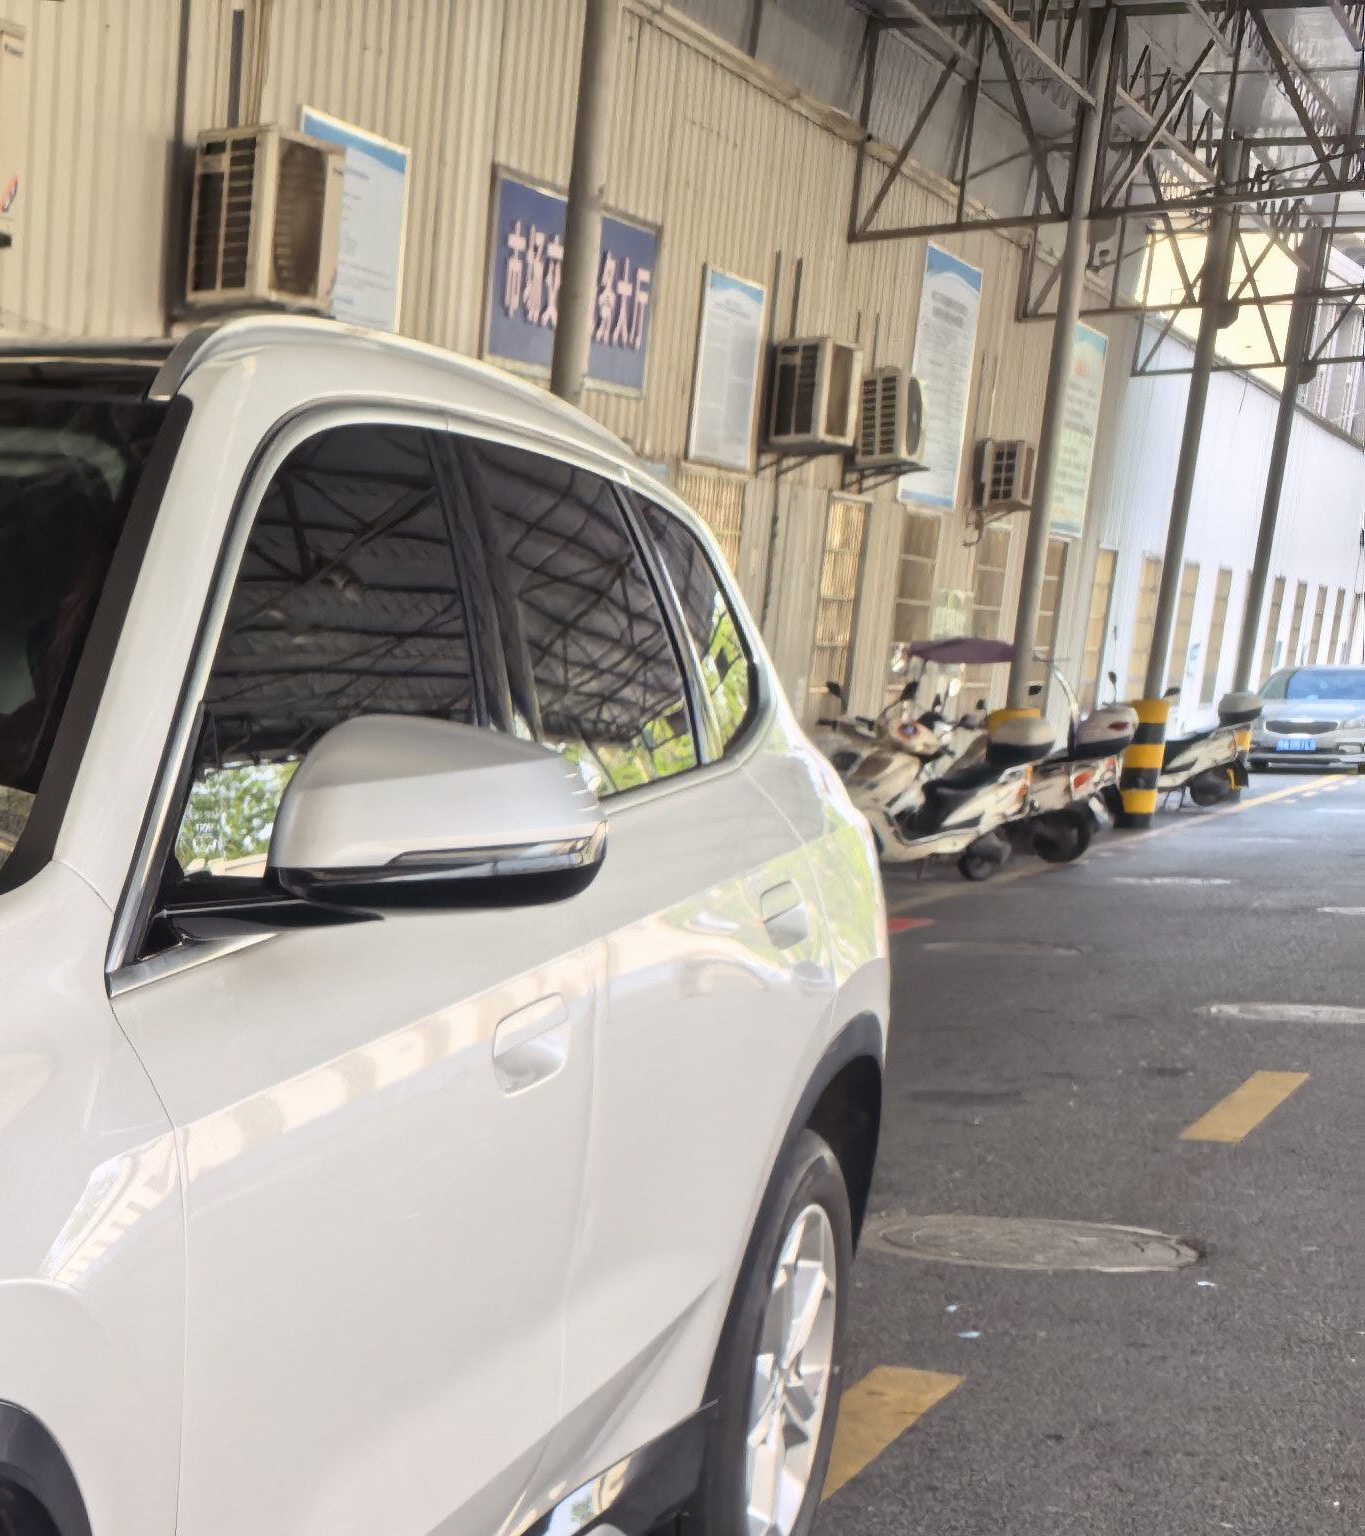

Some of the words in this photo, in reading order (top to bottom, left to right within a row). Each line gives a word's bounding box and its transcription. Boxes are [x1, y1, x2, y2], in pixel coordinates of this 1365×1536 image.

[504, 219, 651, 350] 市场交务大厅
